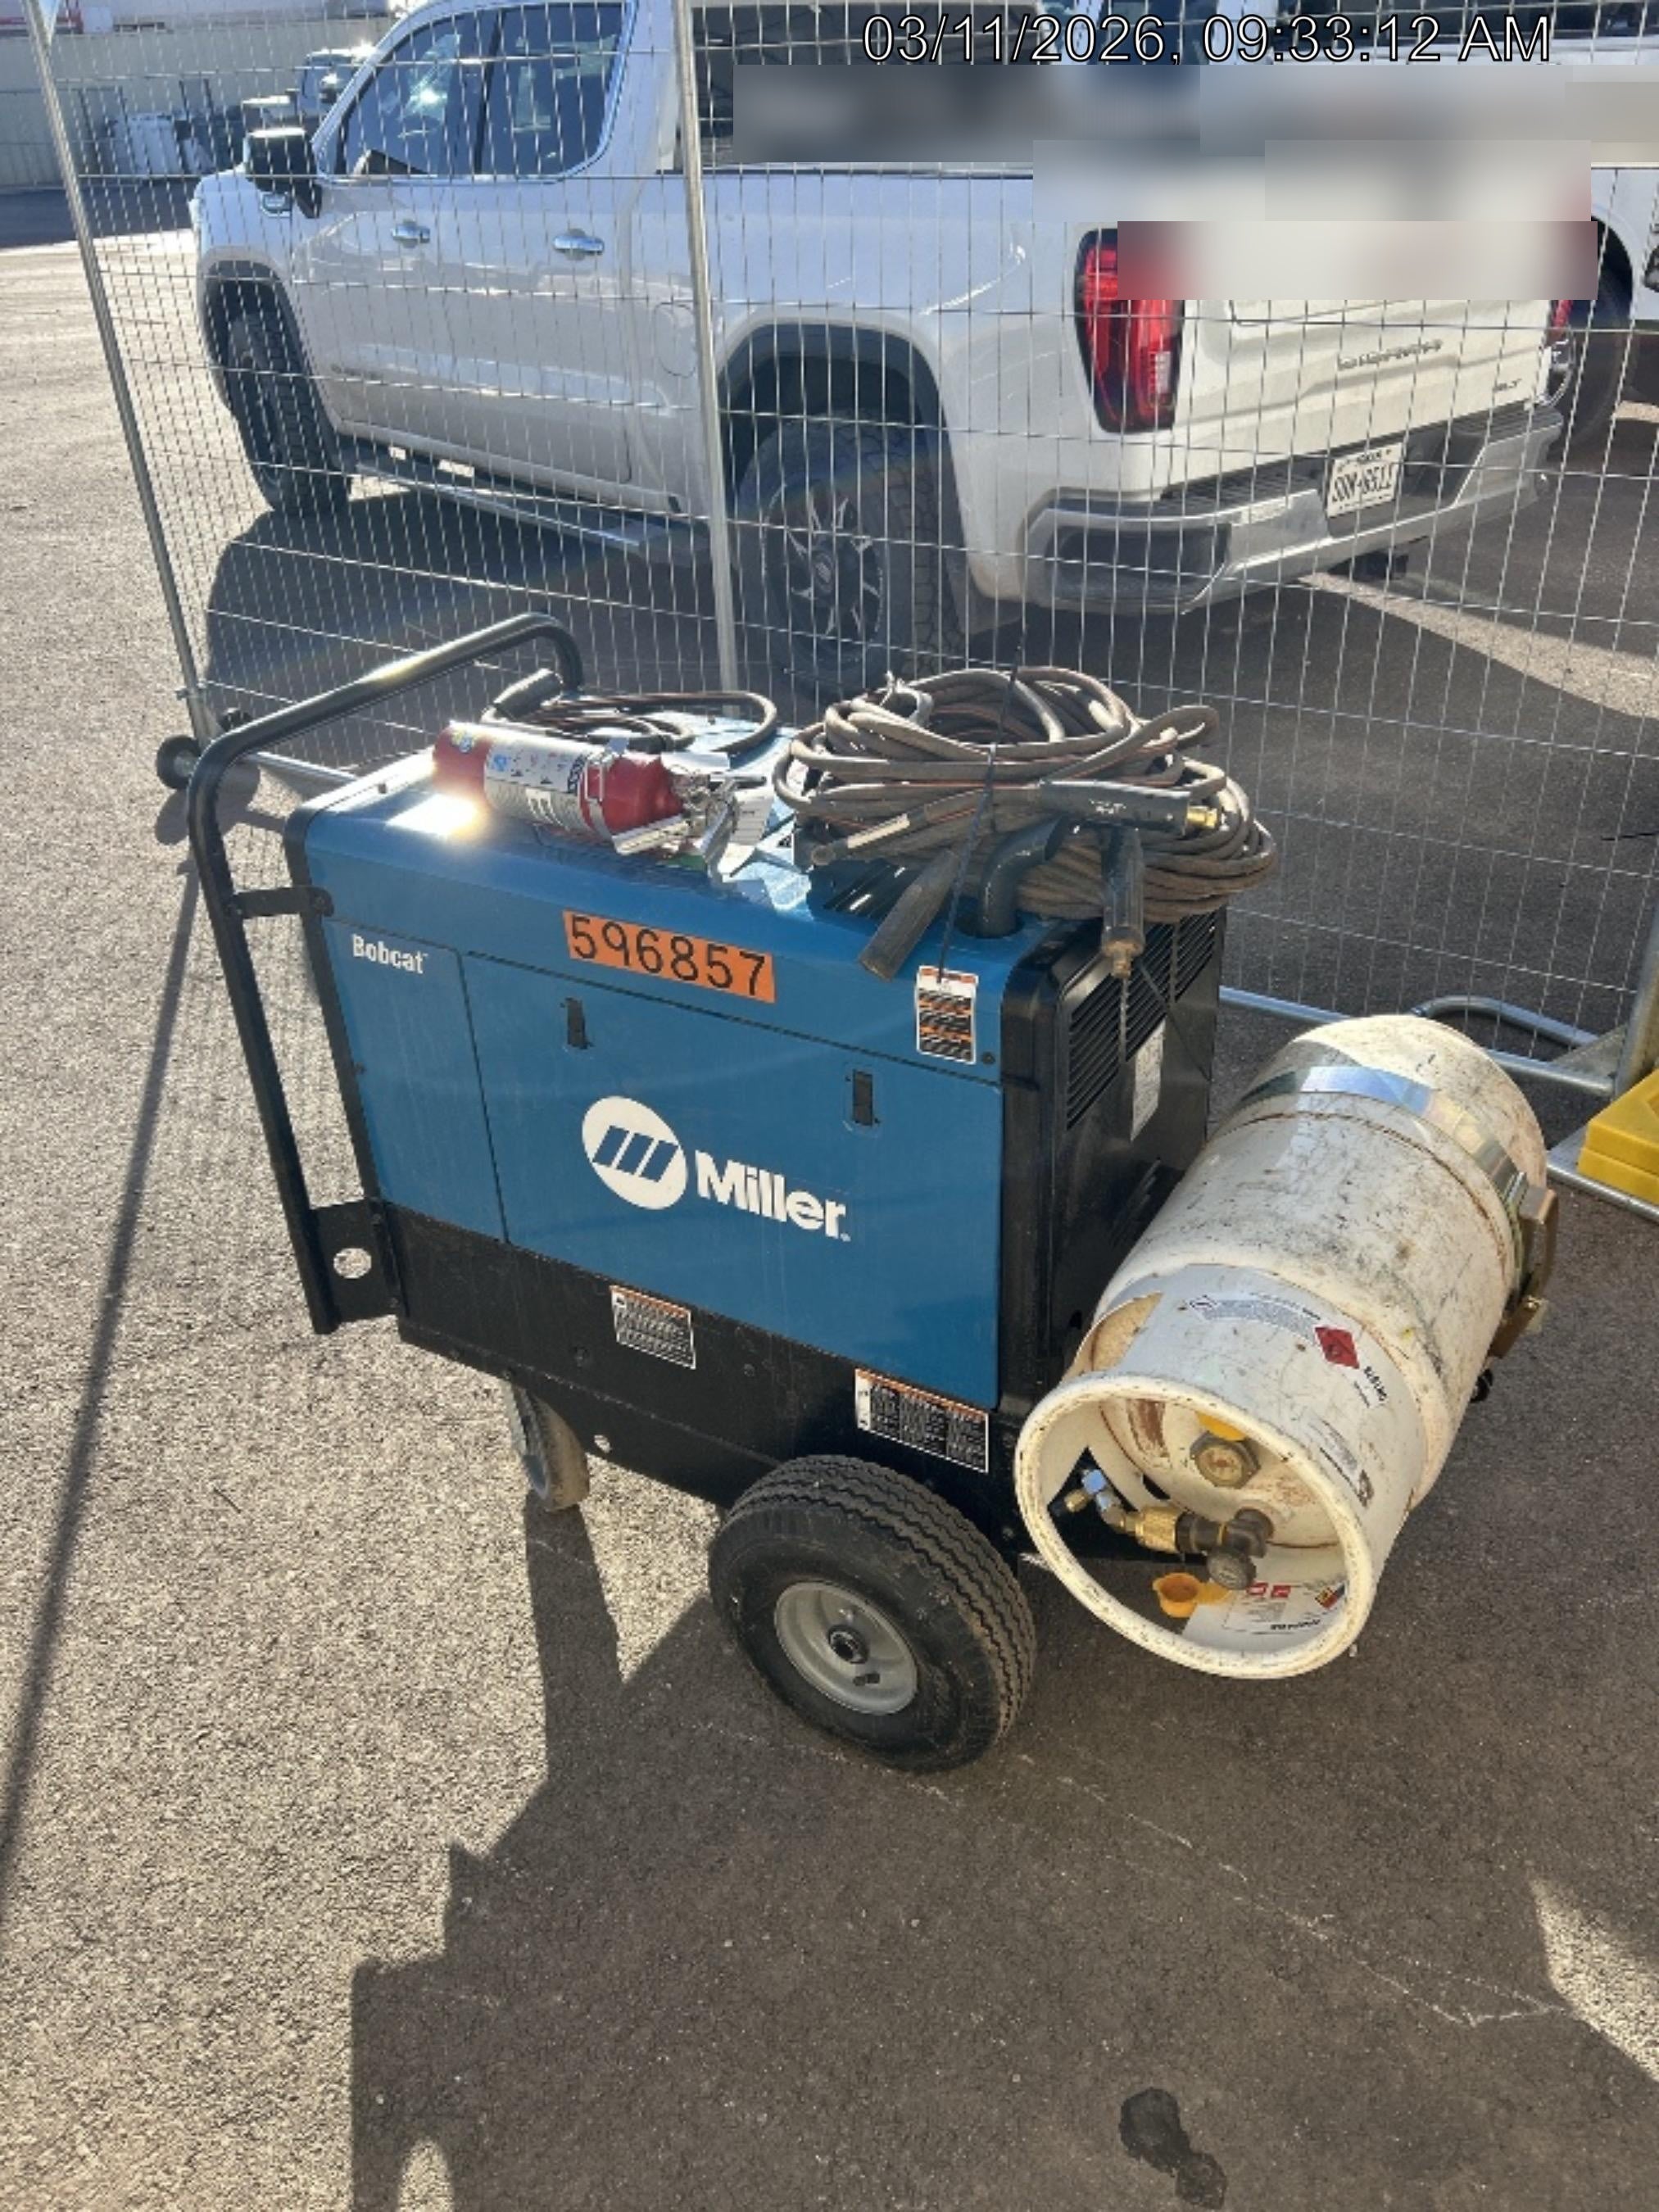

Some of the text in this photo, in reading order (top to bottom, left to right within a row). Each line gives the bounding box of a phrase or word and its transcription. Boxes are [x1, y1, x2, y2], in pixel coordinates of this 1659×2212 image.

[352, 933, 424, 974] Bobcat
[572, 914, 766, 995] 596857
[695, 1149, 846, 1240] Miller
